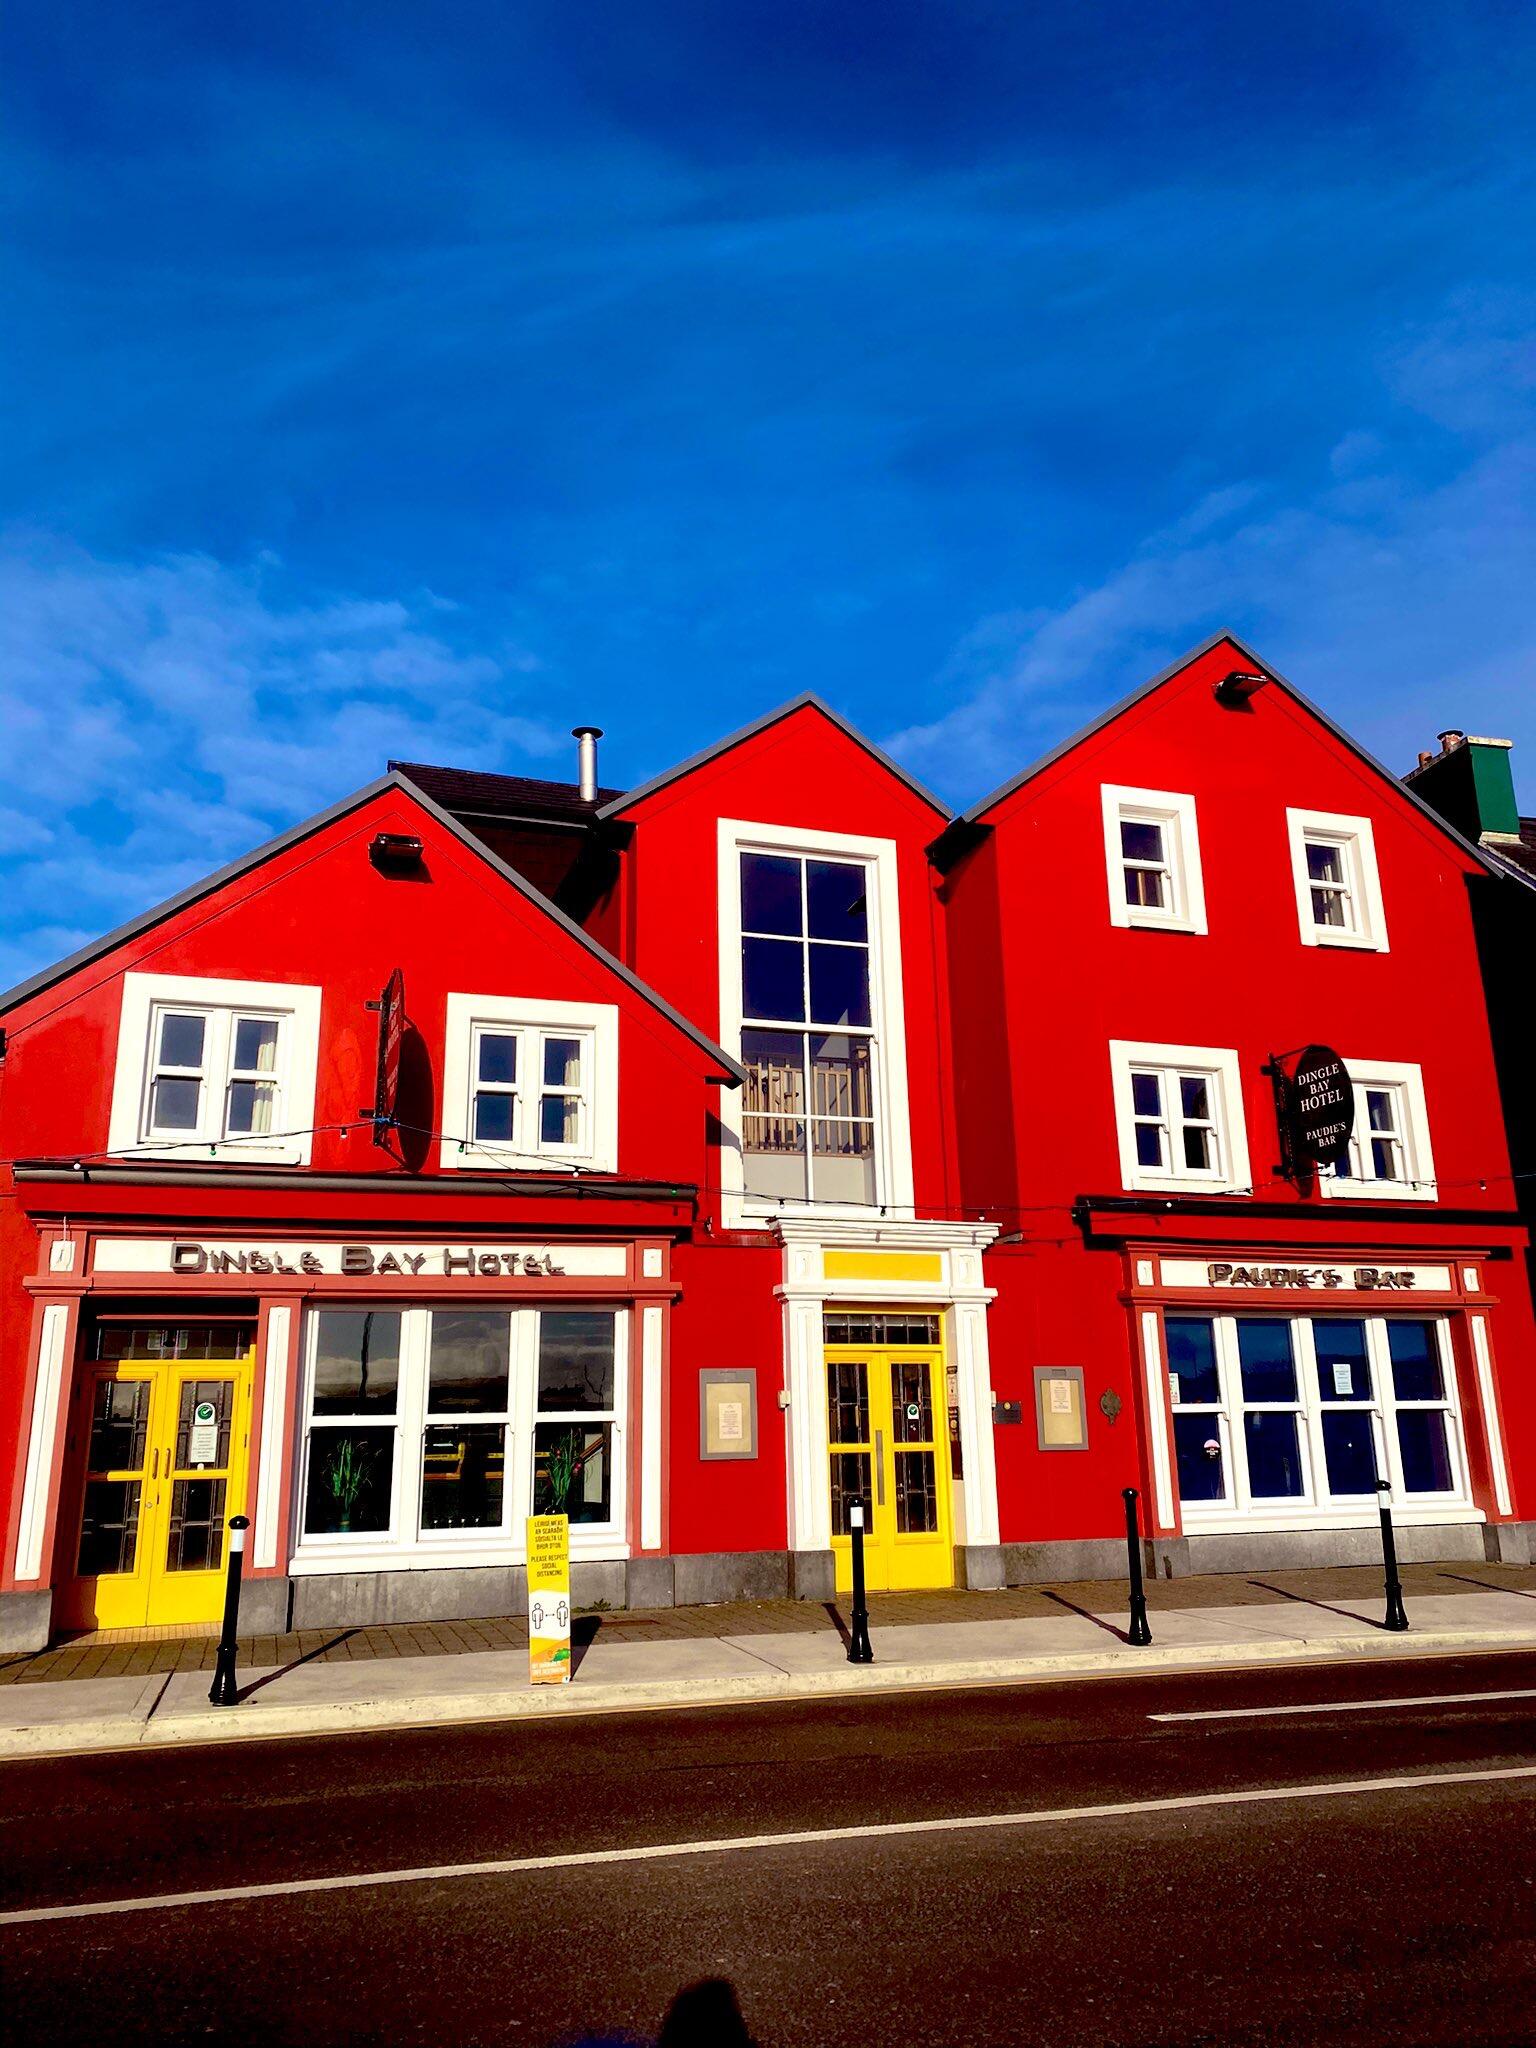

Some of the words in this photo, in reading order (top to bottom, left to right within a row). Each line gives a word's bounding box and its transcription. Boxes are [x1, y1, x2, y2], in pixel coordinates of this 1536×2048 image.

[1298, 1063, 1340, 1086] DINGLE
[1310, 1079, 1329, 1095] BAY
[1300, 1089, 1344, 1112] HOTEL
[1306, 1121, 1347, 1140] PAUDIE'S
[1318, 1135, 1337, 1148] BAR
[170, 1243, 323, 1274] DINGLE
[341, 1246, 426, 1276] BAY
[443, 1248, 566, 1277] HOTEL
[1208, 1264, 1343, 1288] PAUDIE'S
[1355, 1268, 1416, 1290] BAR
